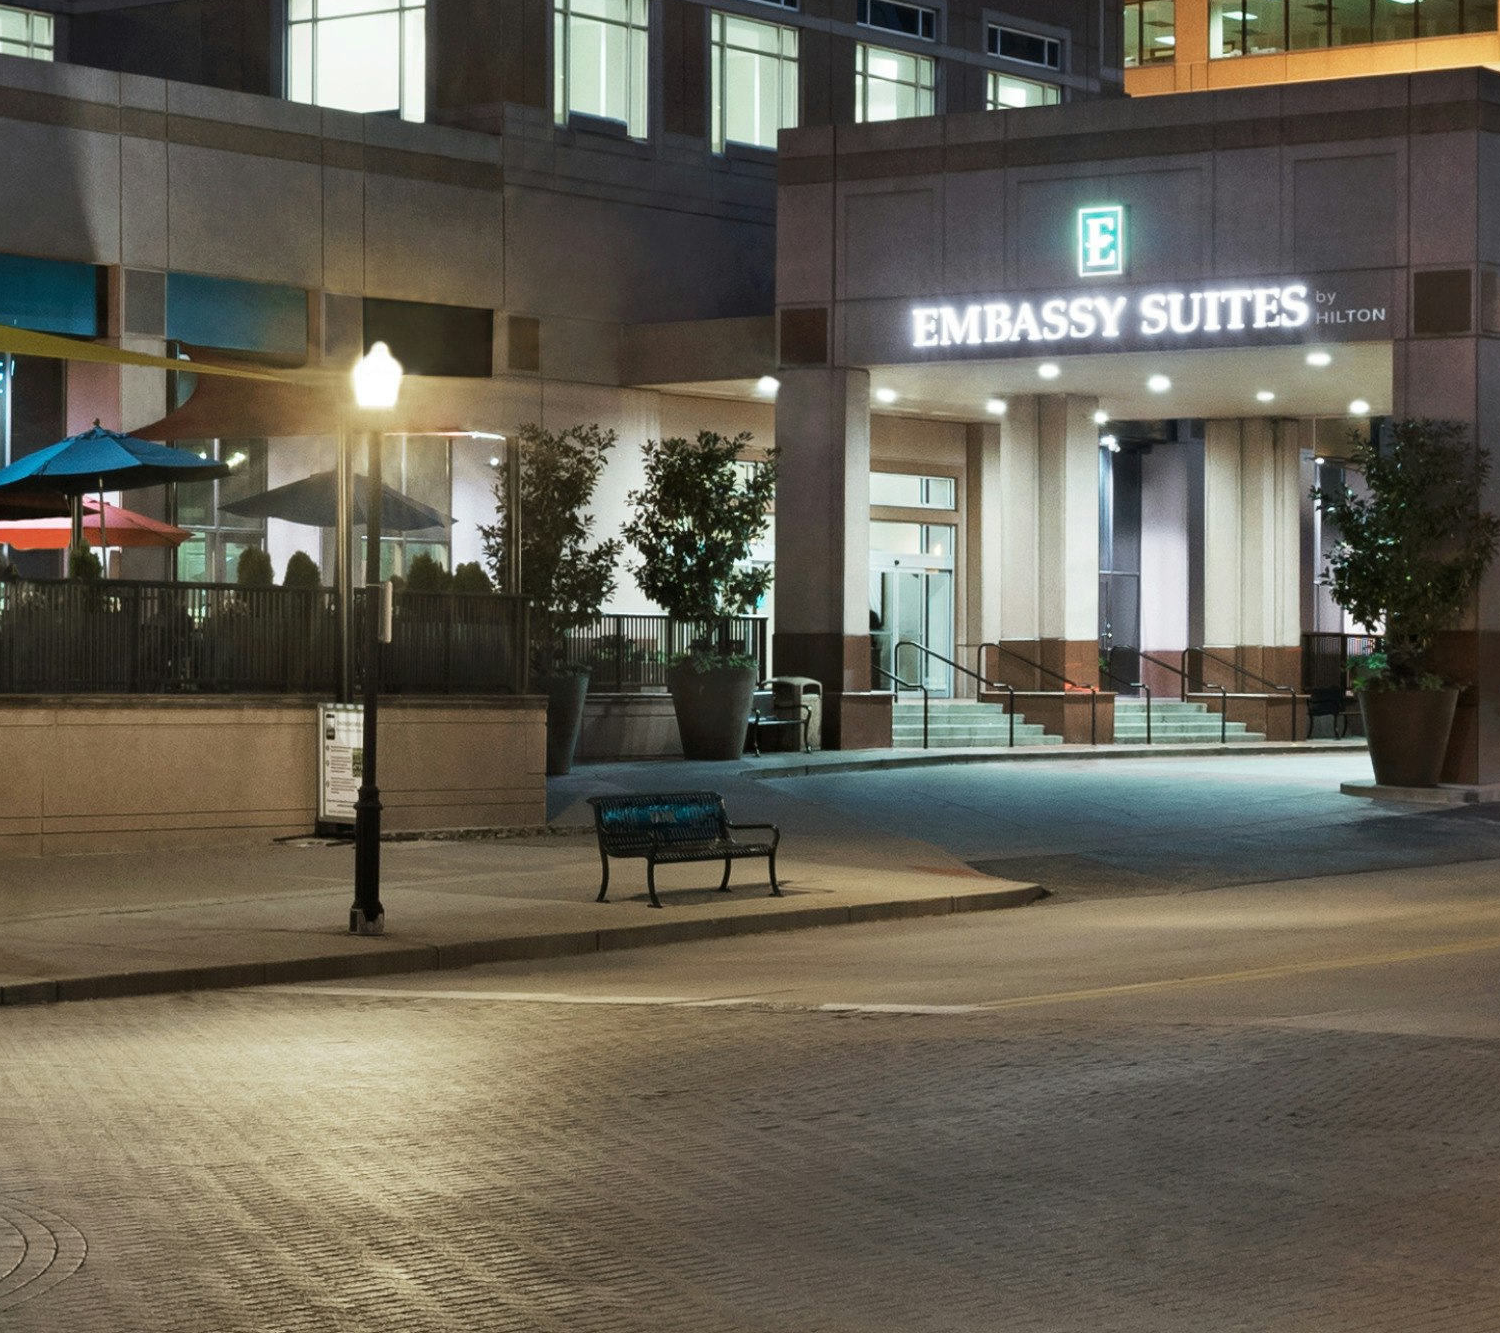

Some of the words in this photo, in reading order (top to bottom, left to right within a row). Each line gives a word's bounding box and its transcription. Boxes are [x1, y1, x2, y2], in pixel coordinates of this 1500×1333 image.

[1315, 290, 1337, 306] by
[911, 296, 1127, 348] EMBASSY
[1140, 285, 1310, 335] SUITES
[1316, 308, 1386, 325] HILTON
